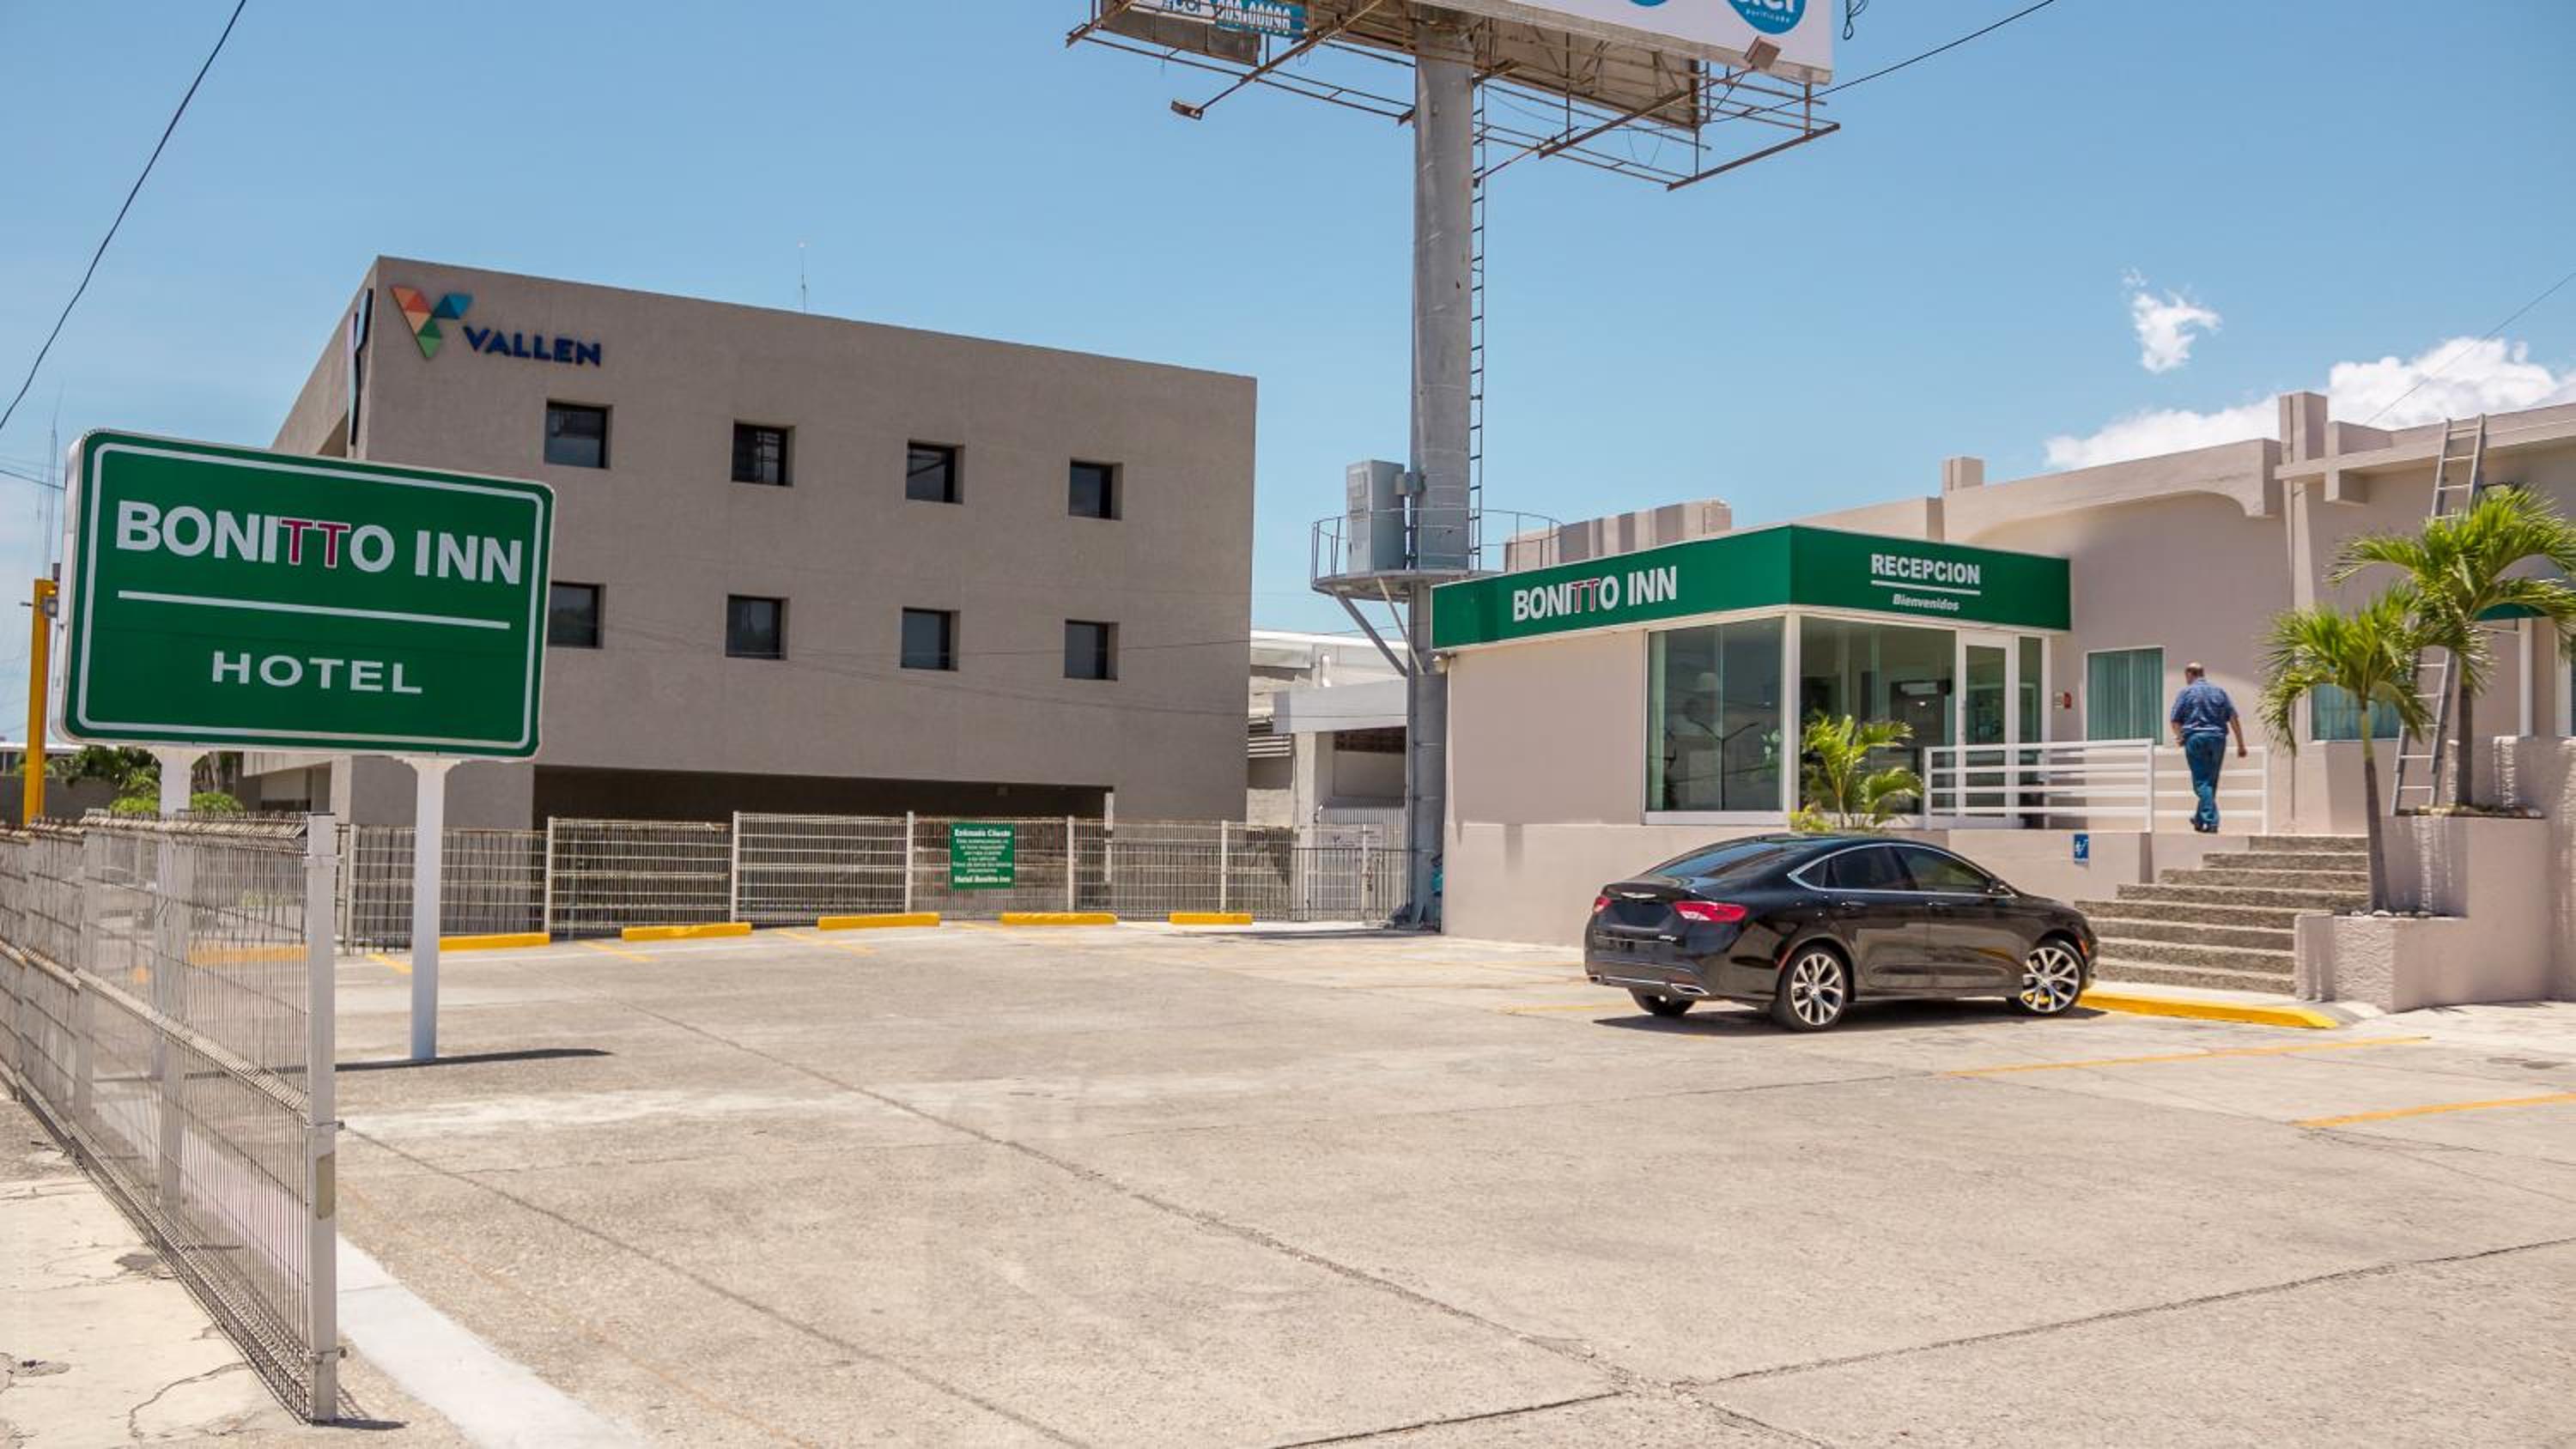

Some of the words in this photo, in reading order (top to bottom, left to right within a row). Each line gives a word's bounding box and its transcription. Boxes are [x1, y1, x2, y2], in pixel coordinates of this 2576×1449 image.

[462, 325, 601, 367] VALLEN
[116, 500, 395, 573] BONITTO
[415, 530, 522, 585] INN
[1871, 554, 1980, 585] RECEPCION
[1513, 575, 1619, 621] BONITTO
[1627, 566, 1677, 606] INN
[1893, 593, 1959, 611] Bienvenidos
[211, 651, 422, 694] HOTEL
